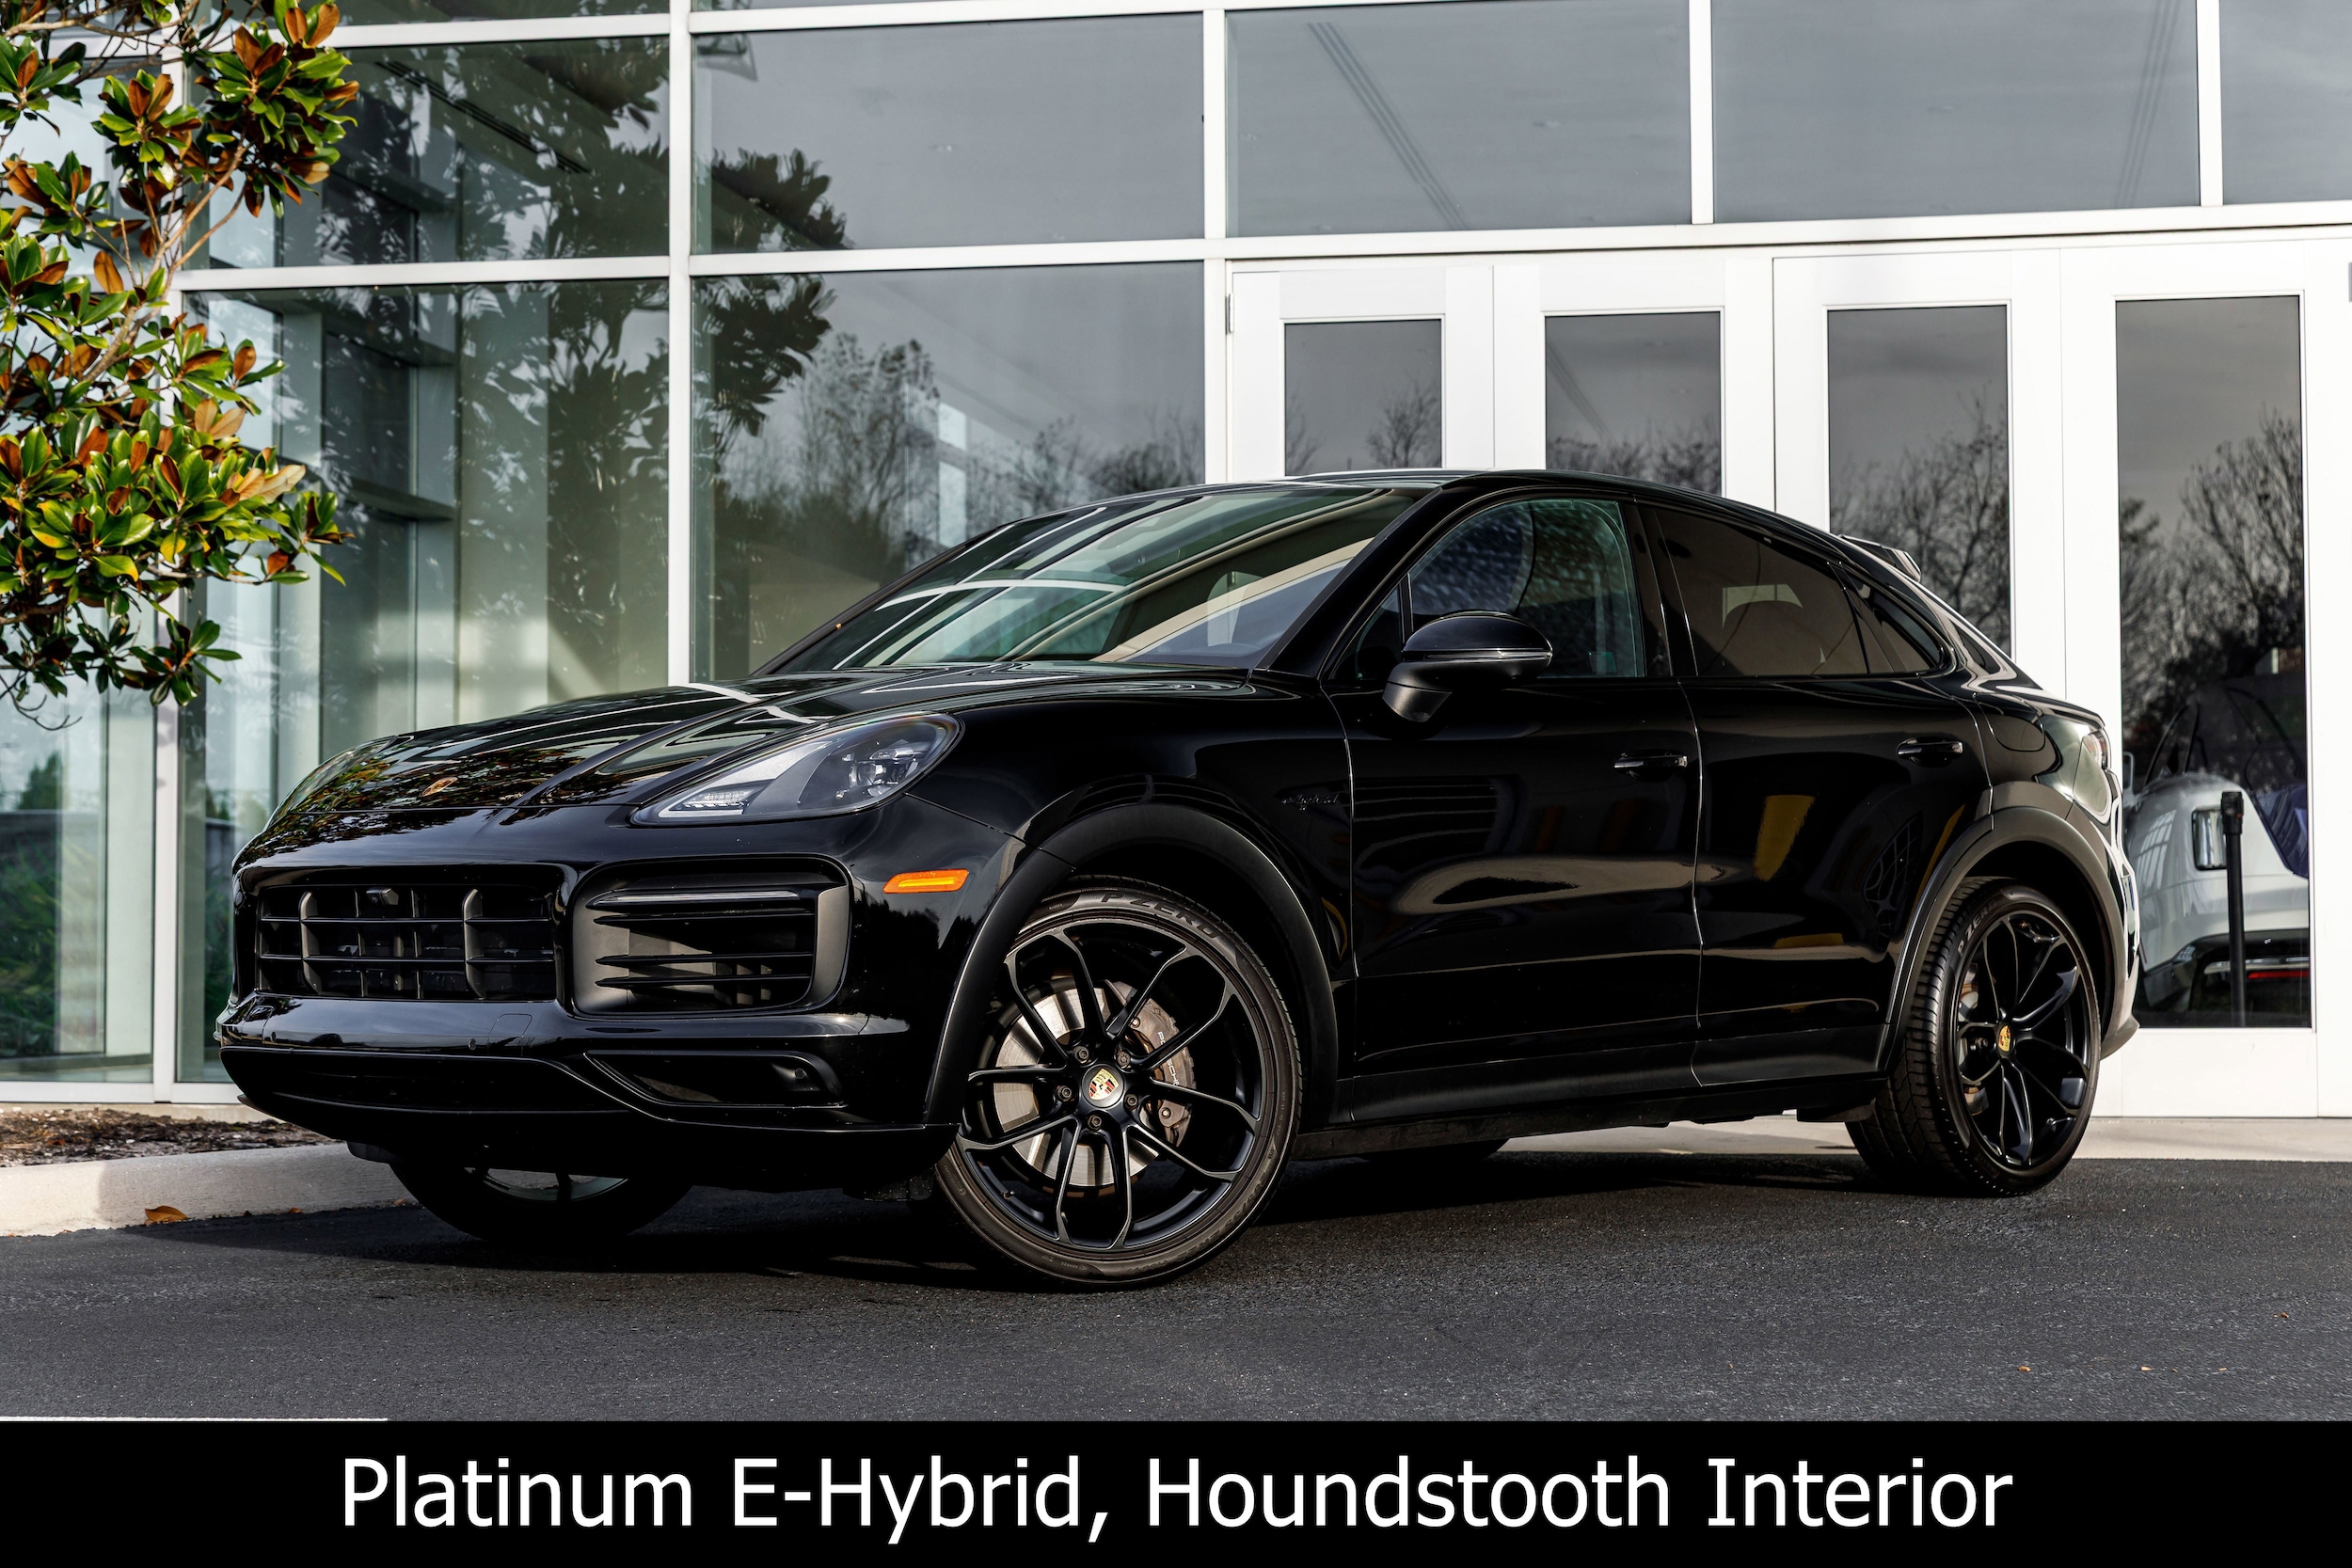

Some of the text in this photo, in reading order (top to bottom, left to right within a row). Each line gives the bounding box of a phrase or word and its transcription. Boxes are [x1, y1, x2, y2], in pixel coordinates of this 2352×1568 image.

[1101, 892, 1220, 940] P ZERO
[1958, 901, 1997, 957] P ZERO
